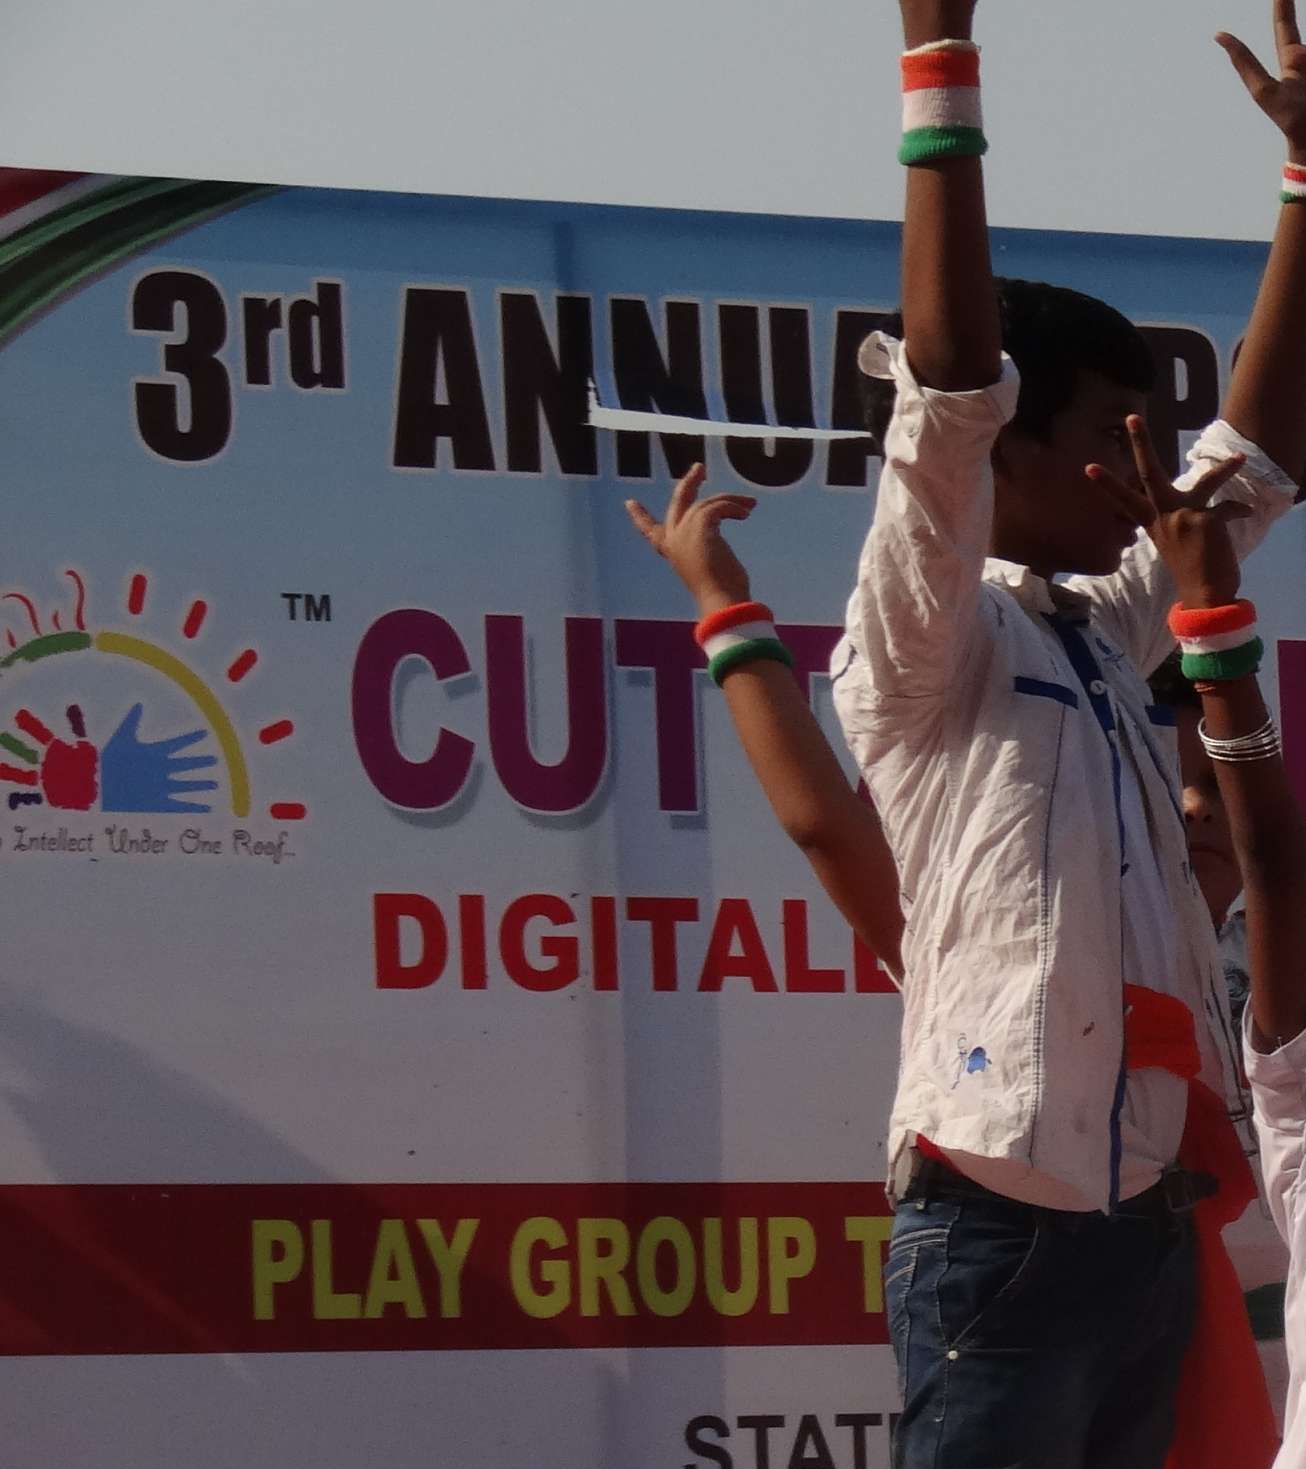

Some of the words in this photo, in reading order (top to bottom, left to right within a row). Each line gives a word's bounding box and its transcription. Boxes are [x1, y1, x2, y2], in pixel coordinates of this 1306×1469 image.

[131, 269, 347, 463] 3rd
[391, 286, 892, 489] ANNUA
[281, 592, 332, 622] TM
[13, 825, 94, 853] Intellect
[104, 824, 169, 854] Under
[178, 828, 223, 855] One
[250, 1217, 480, 1322] PLAY
[508, 1215, 818, 1320] GROUP
[844, 1215, 897, 1314] T
